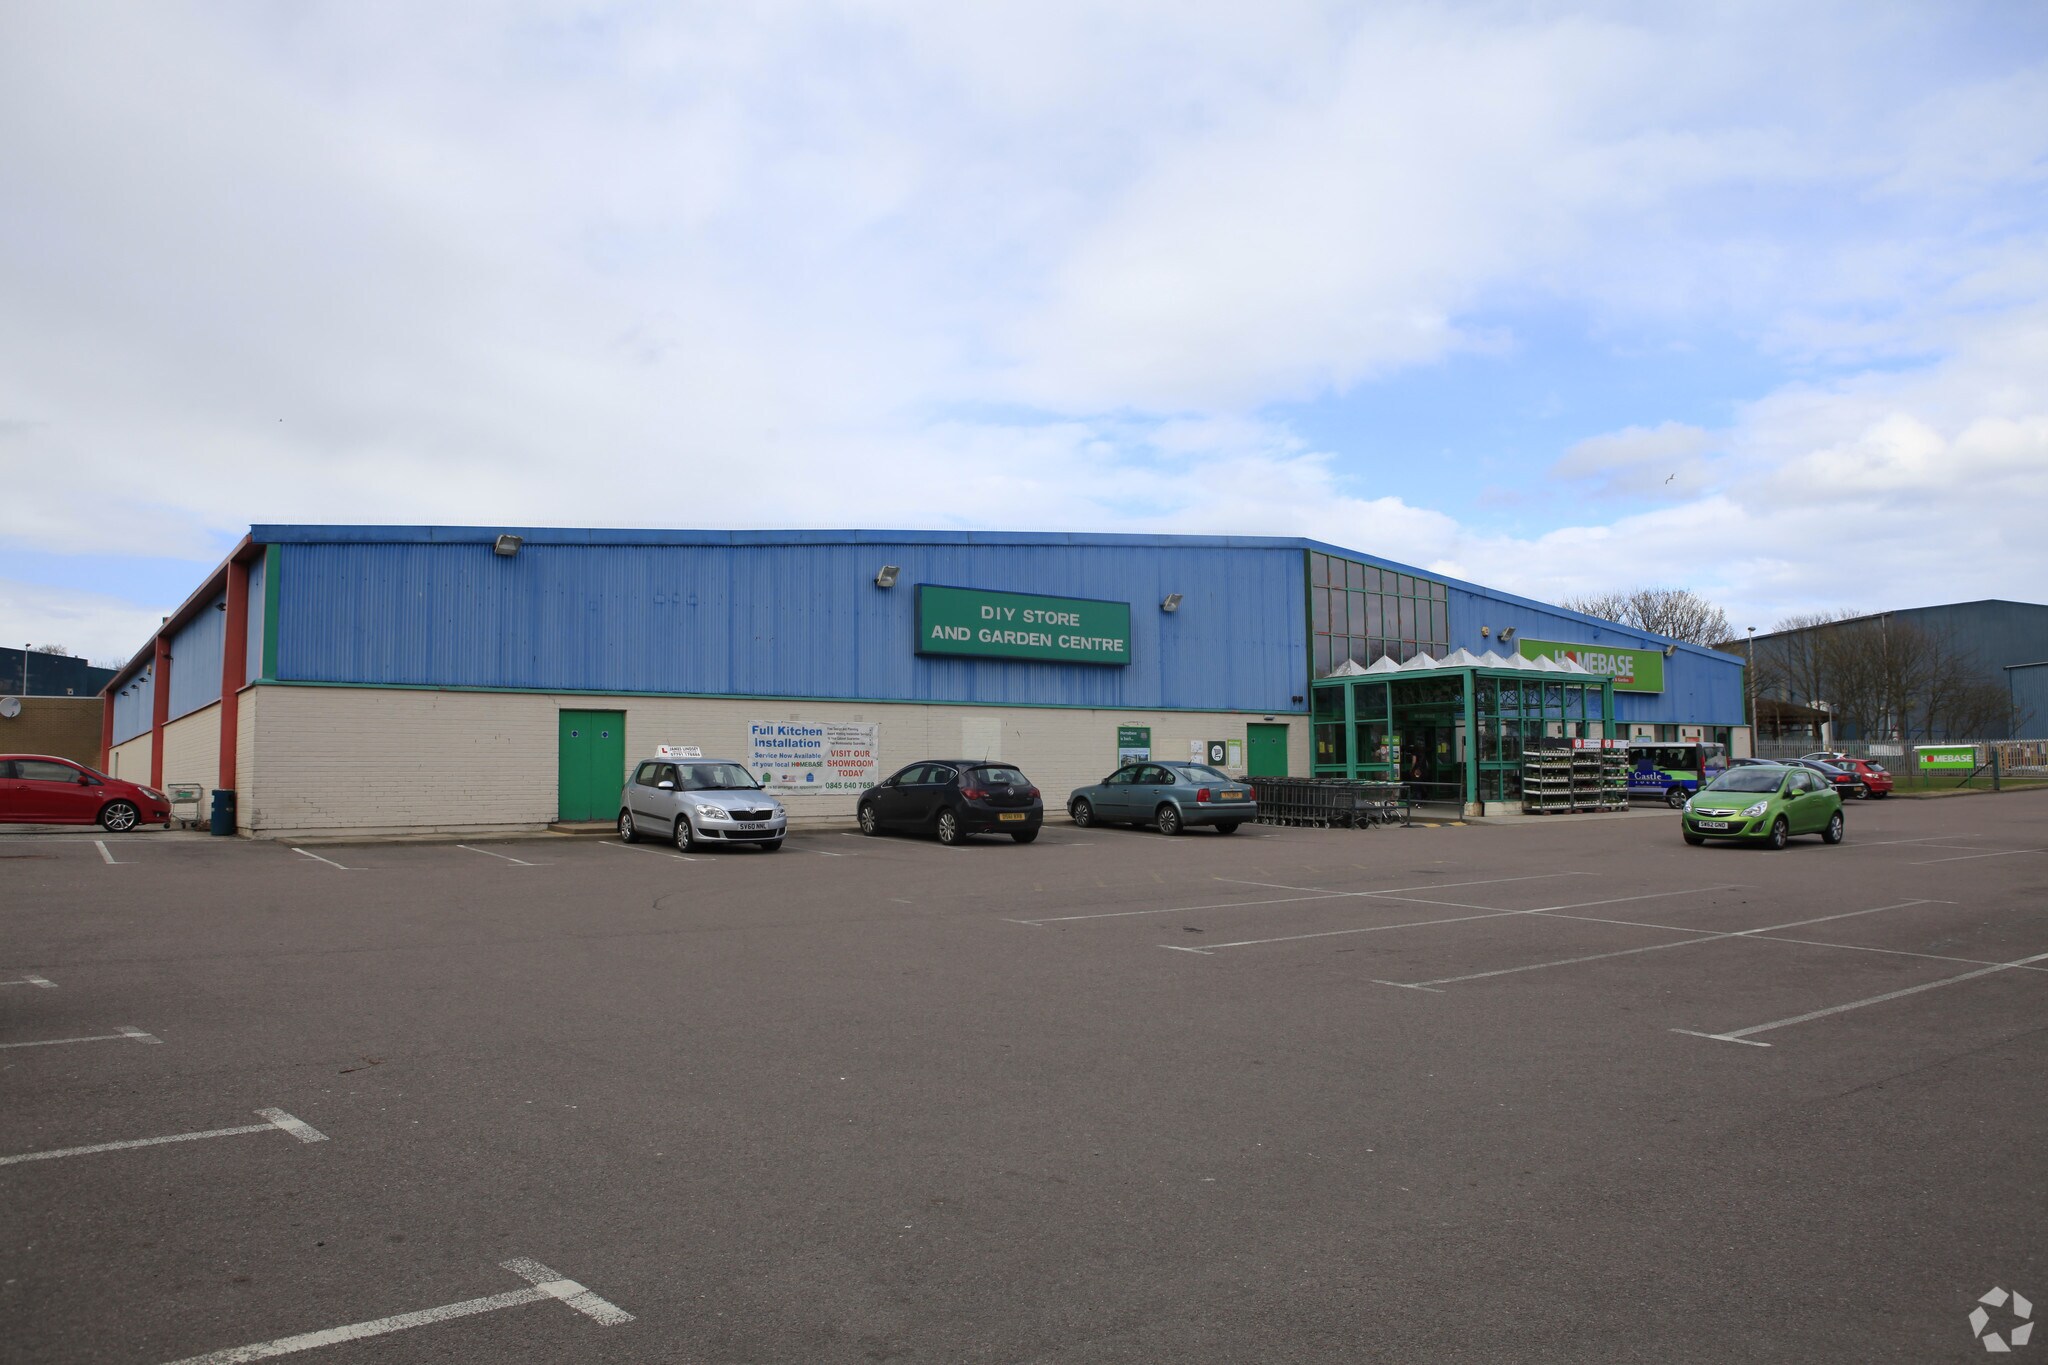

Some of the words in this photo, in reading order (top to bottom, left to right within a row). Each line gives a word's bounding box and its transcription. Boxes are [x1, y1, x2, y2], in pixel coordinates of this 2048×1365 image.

[981, 605, 1016, 621] DIY
[1023, 609, 1080, 627] STORE
[931, 625, 971, 641] AND
[978, 629, 1052, 647] GARDEN
[1058, 635, 1124, 652] CENTRE
[752, 725, 774, 735] Full
[777, 726, 823, 736] Kitchen
[754, 738, 821, 748] Installation
[1920, 754, 1973, 762] HOMEBASE
[1634, 771, 1662, 780] Castle
